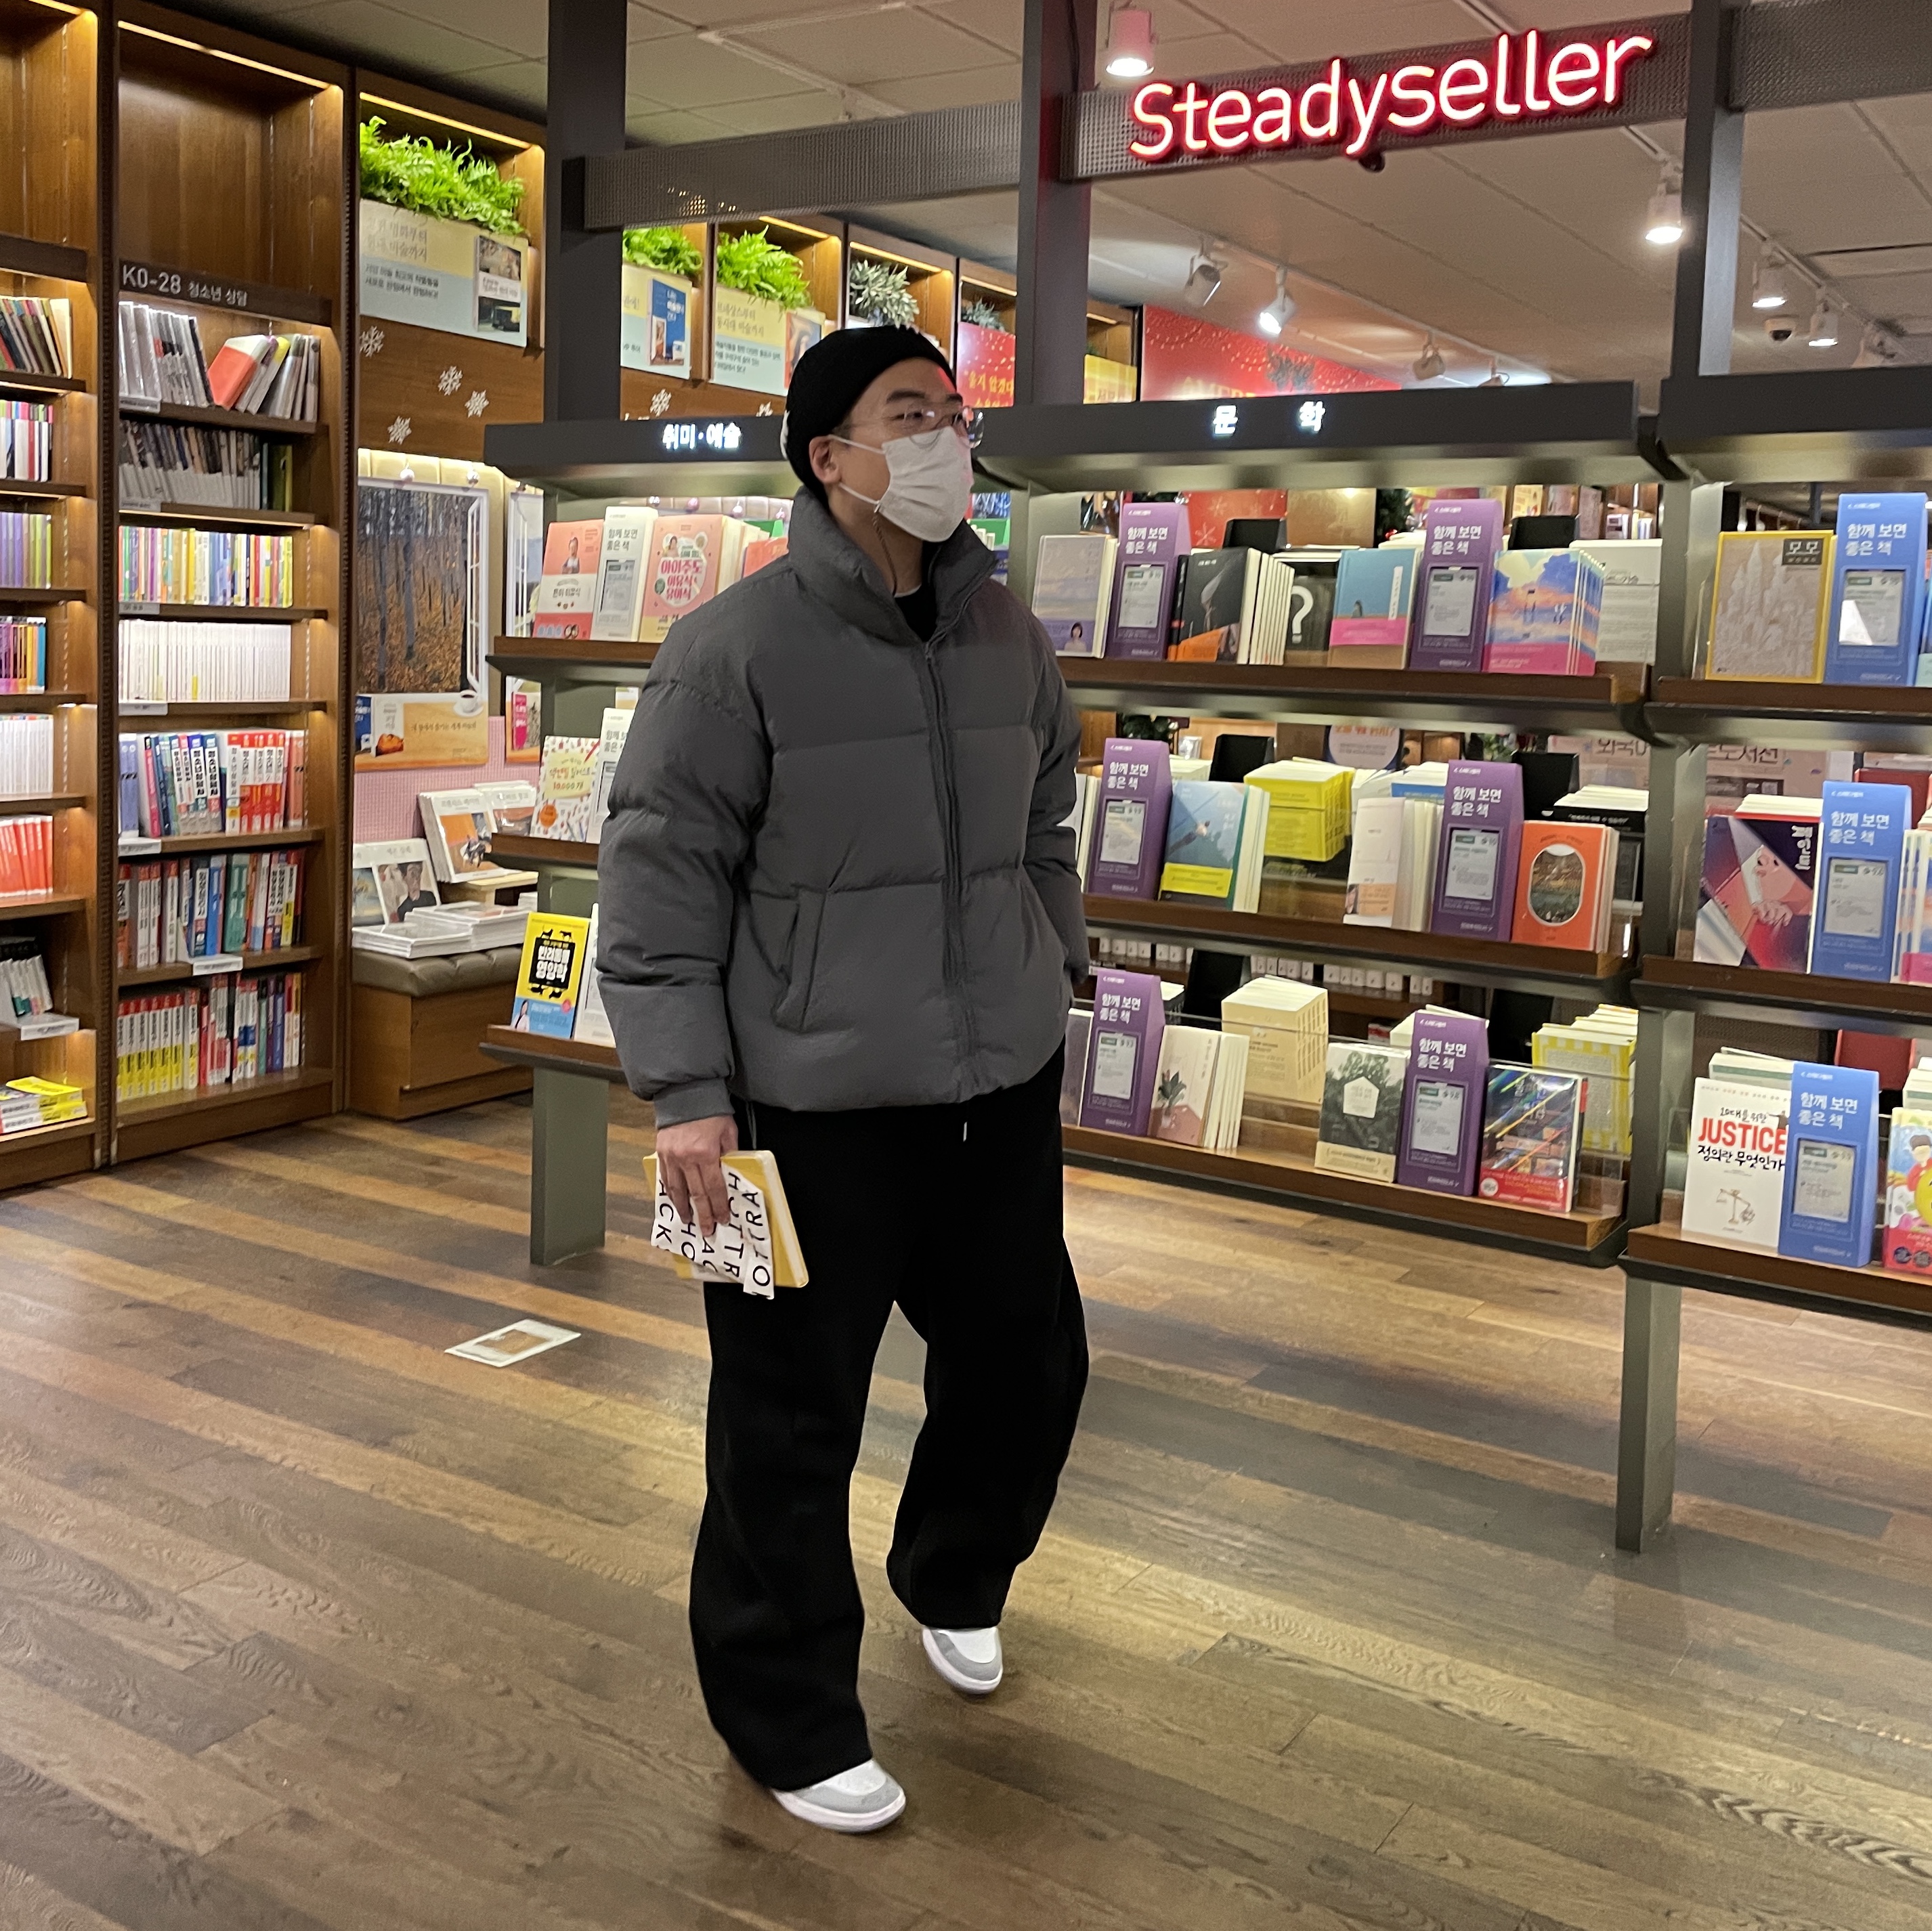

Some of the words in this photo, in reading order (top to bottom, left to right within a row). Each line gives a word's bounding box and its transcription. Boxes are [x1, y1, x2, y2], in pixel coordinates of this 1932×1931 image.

[1130, 29, 1654, 156] Steadyseller
[1212, 405, 1239, 435] 문
[1299, 400, 1326, 433] 학
[662, 422, 742, 450] 취미·예술
[1128, 527, 1148, 541] 함께
[1148, 526, 1169, 541] 보면
[1434, 525, 1457, 540] 함께
[1458, 525, 1482, 540] 보면
[1847, 523, 1876, 539] 함께
[1878, 523, 1908, 539] 보면
[1125, 541, 1145, 555] 좋은
[1146, 540, 1158, 556] 책
[1431, 541, 1455, 555] 좋은
[1456, 541, 1469, 556] 책
[1845, 541, 1874, 557] 좋은
[1878, 541, 1893, 557] 책
[1109, 762, 1129, 775] 함께
[1130, 764, 1149, 777] 보면
[1107, 776, 1127, 789] 좋은
[1128, 777, 1138, 791] 책
[1453, 786, 1476, 802] 함께
[1477, 788, 1502, 804] 보면
[1451, 802, 1475, 817] 좋은
[1476, 803, 1490, 819] 책
[1830, 810, 1859, 827] 함께
[1861, 813, 1890, 830] 보면
[1828, 828, 1858, 844] 좋은
[1860, 829, 1876, 846] 책
[1101, 993, 1121, 1008] 함께
[1121, 996, 1141, 1011] 보면
[1099, 1007, 1119, 1022] 좋은
[1120, 1010, 1131, 1024] 책
[1419, 1037, 1442, 1054] 함께
[1443, 1041, 1467, 1058] 보면
[1417, 1054, 1440, 1070] 좋은
[1442, 1056, 1455, 1072] 책
[1800, 1092, 1828, 1110] 함께
[1830, 1096, 1858, 1114] 보면
[1798, 1110, 1826, 1127] 좋은
[1828, 1112, 1844, 1130] 책
[1698, 1117, 1787, 1155] JUSTICE
[1698, 1144, 1733, 1164] 정의란
[1734, 1151, 1786, 1172] 무엇인가
